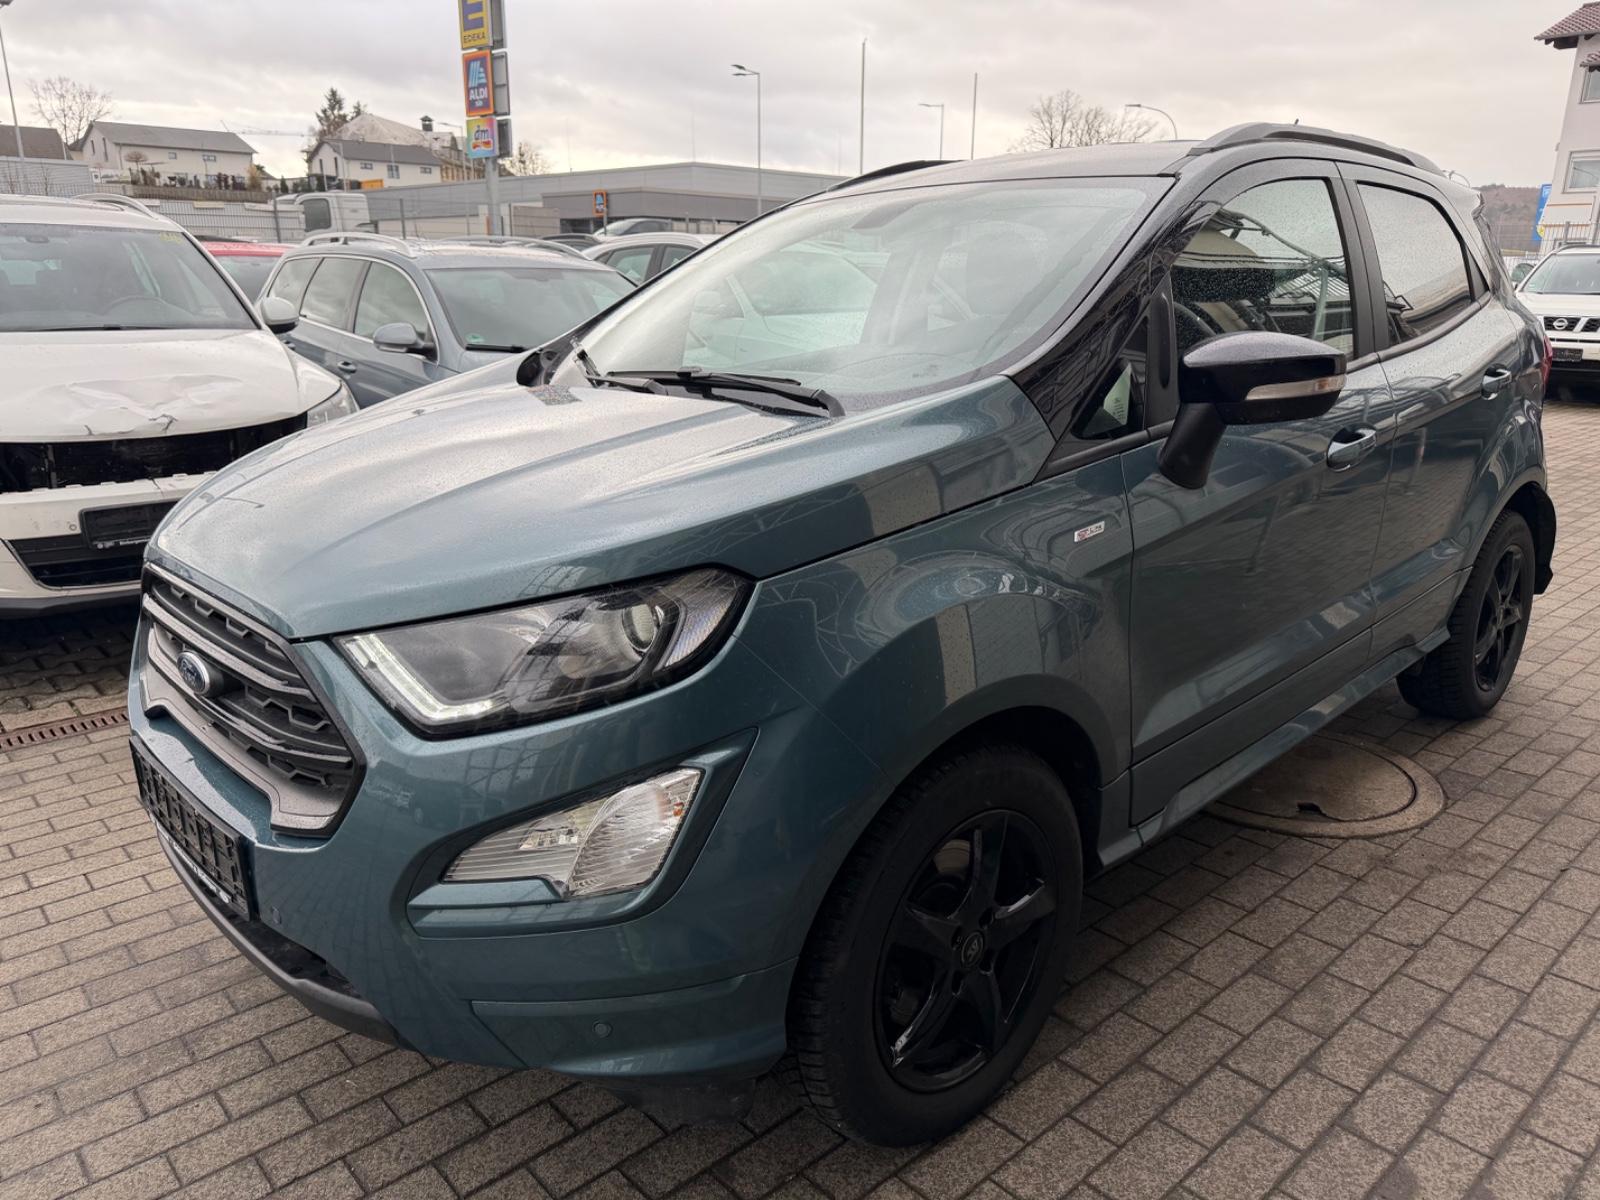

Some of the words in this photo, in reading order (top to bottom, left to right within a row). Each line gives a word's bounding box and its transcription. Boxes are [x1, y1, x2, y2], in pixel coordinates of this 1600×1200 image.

[463, 32, 485, 43] EDEKA
[469, 87, 488, 100] ALDI
[474, 125, 489, 140] dm
